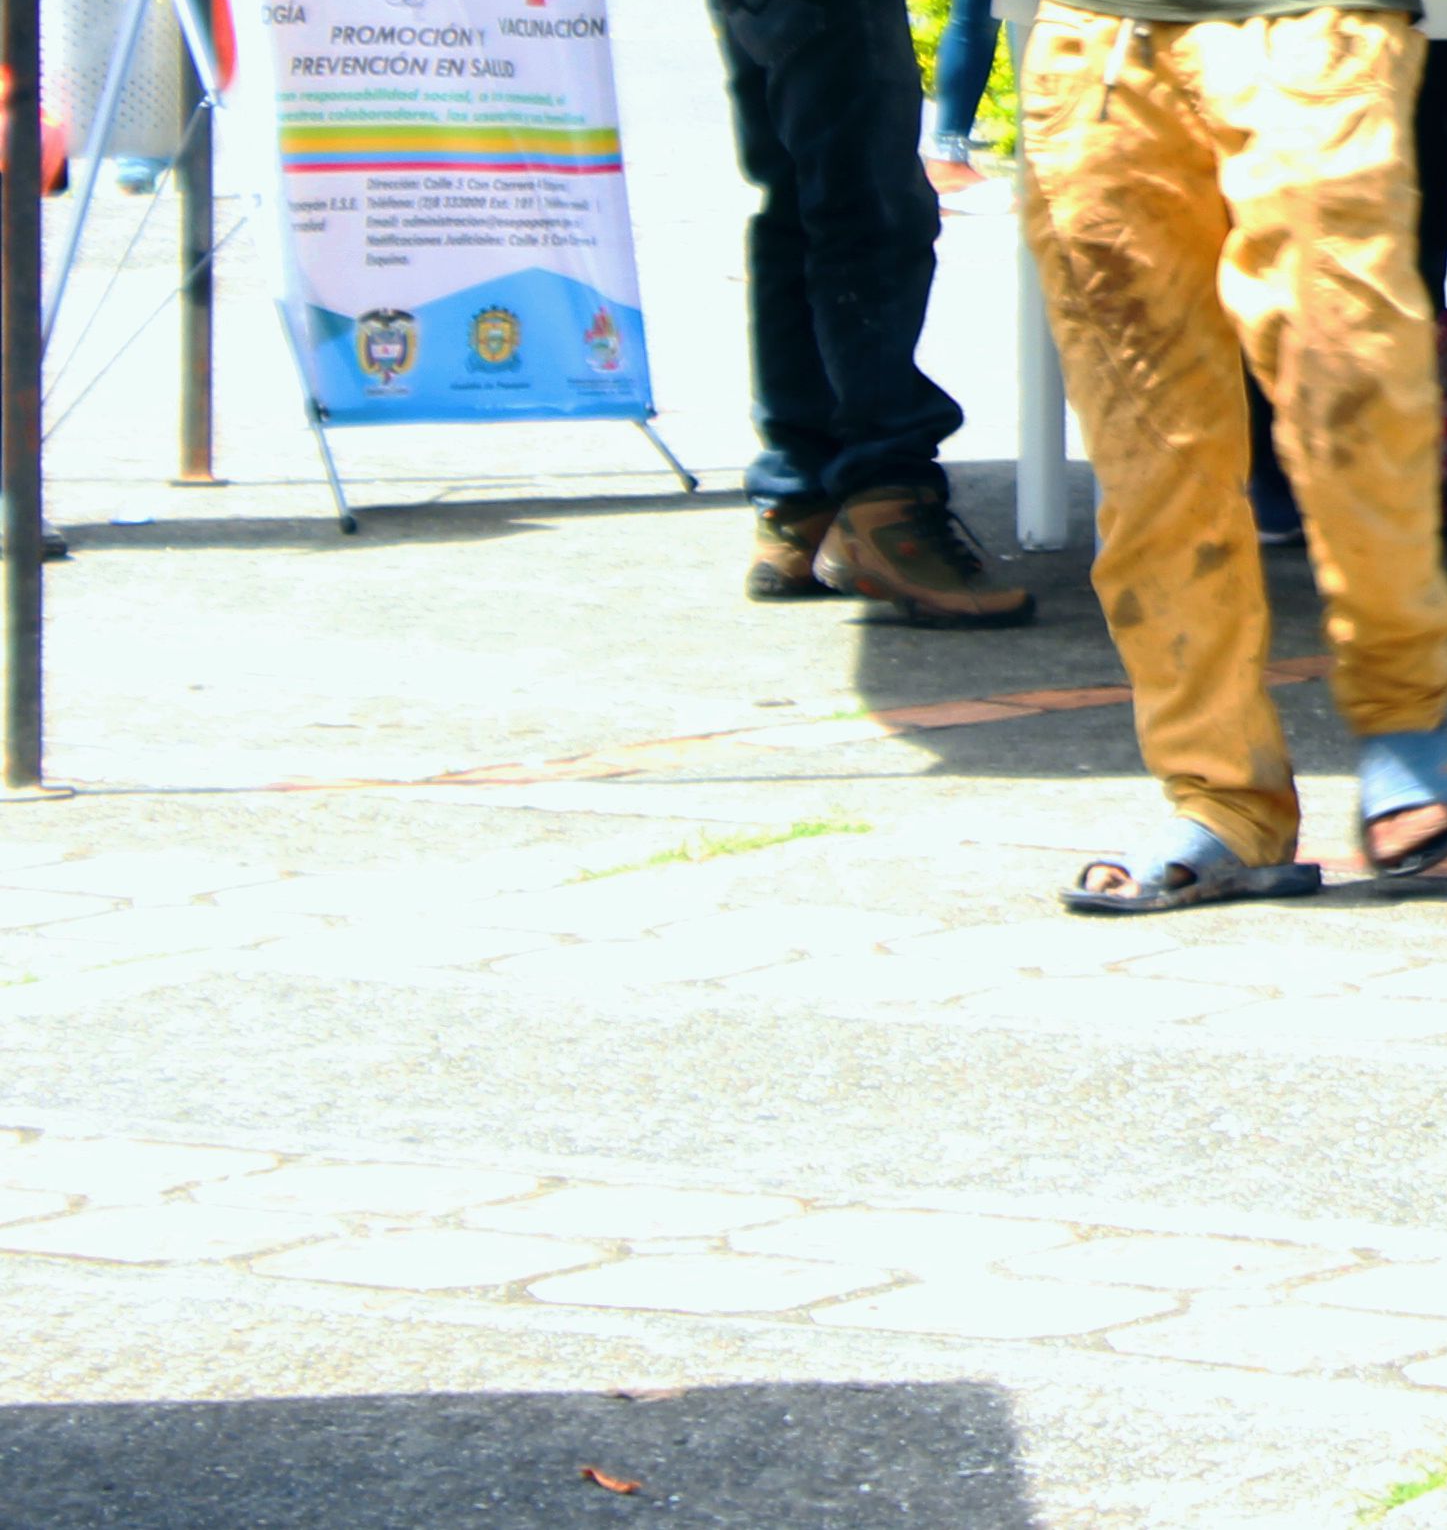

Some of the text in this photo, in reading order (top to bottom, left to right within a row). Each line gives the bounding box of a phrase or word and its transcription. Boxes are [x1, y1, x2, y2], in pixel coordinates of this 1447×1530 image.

[331, 22, 473, 47] PROMOCIÓN
[499, 14, 606, 40] VACUNACIÓN
[291, 50, 516, 79] PREVENCIÓN EN SALUD
